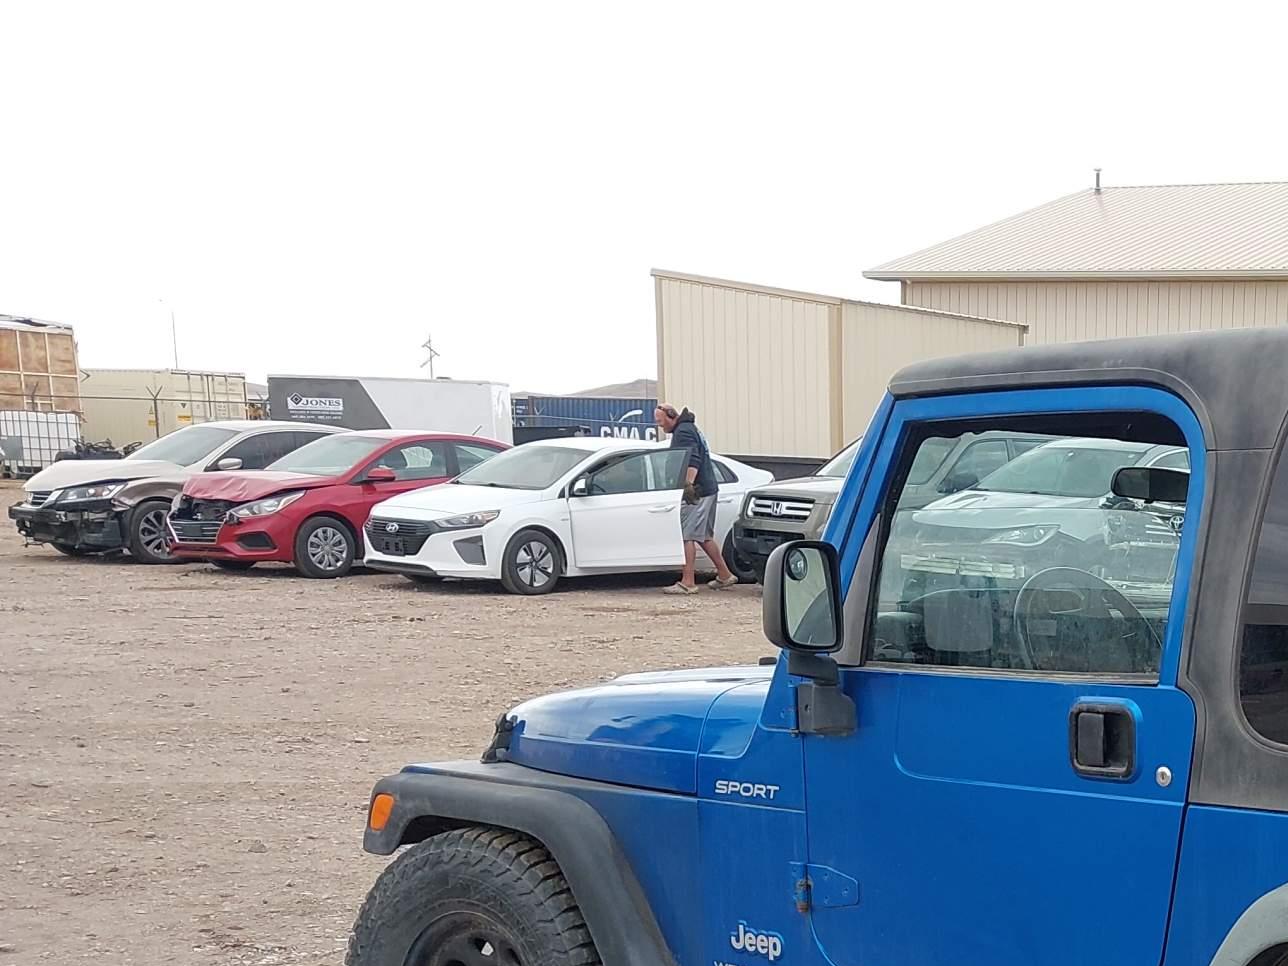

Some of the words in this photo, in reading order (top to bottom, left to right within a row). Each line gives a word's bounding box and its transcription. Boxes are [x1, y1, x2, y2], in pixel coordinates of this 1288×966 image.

[302, 399, 341, 407] JONES
[714, 779, 780, 799] SPORT
[730, 923, 783, 961] Jeep
